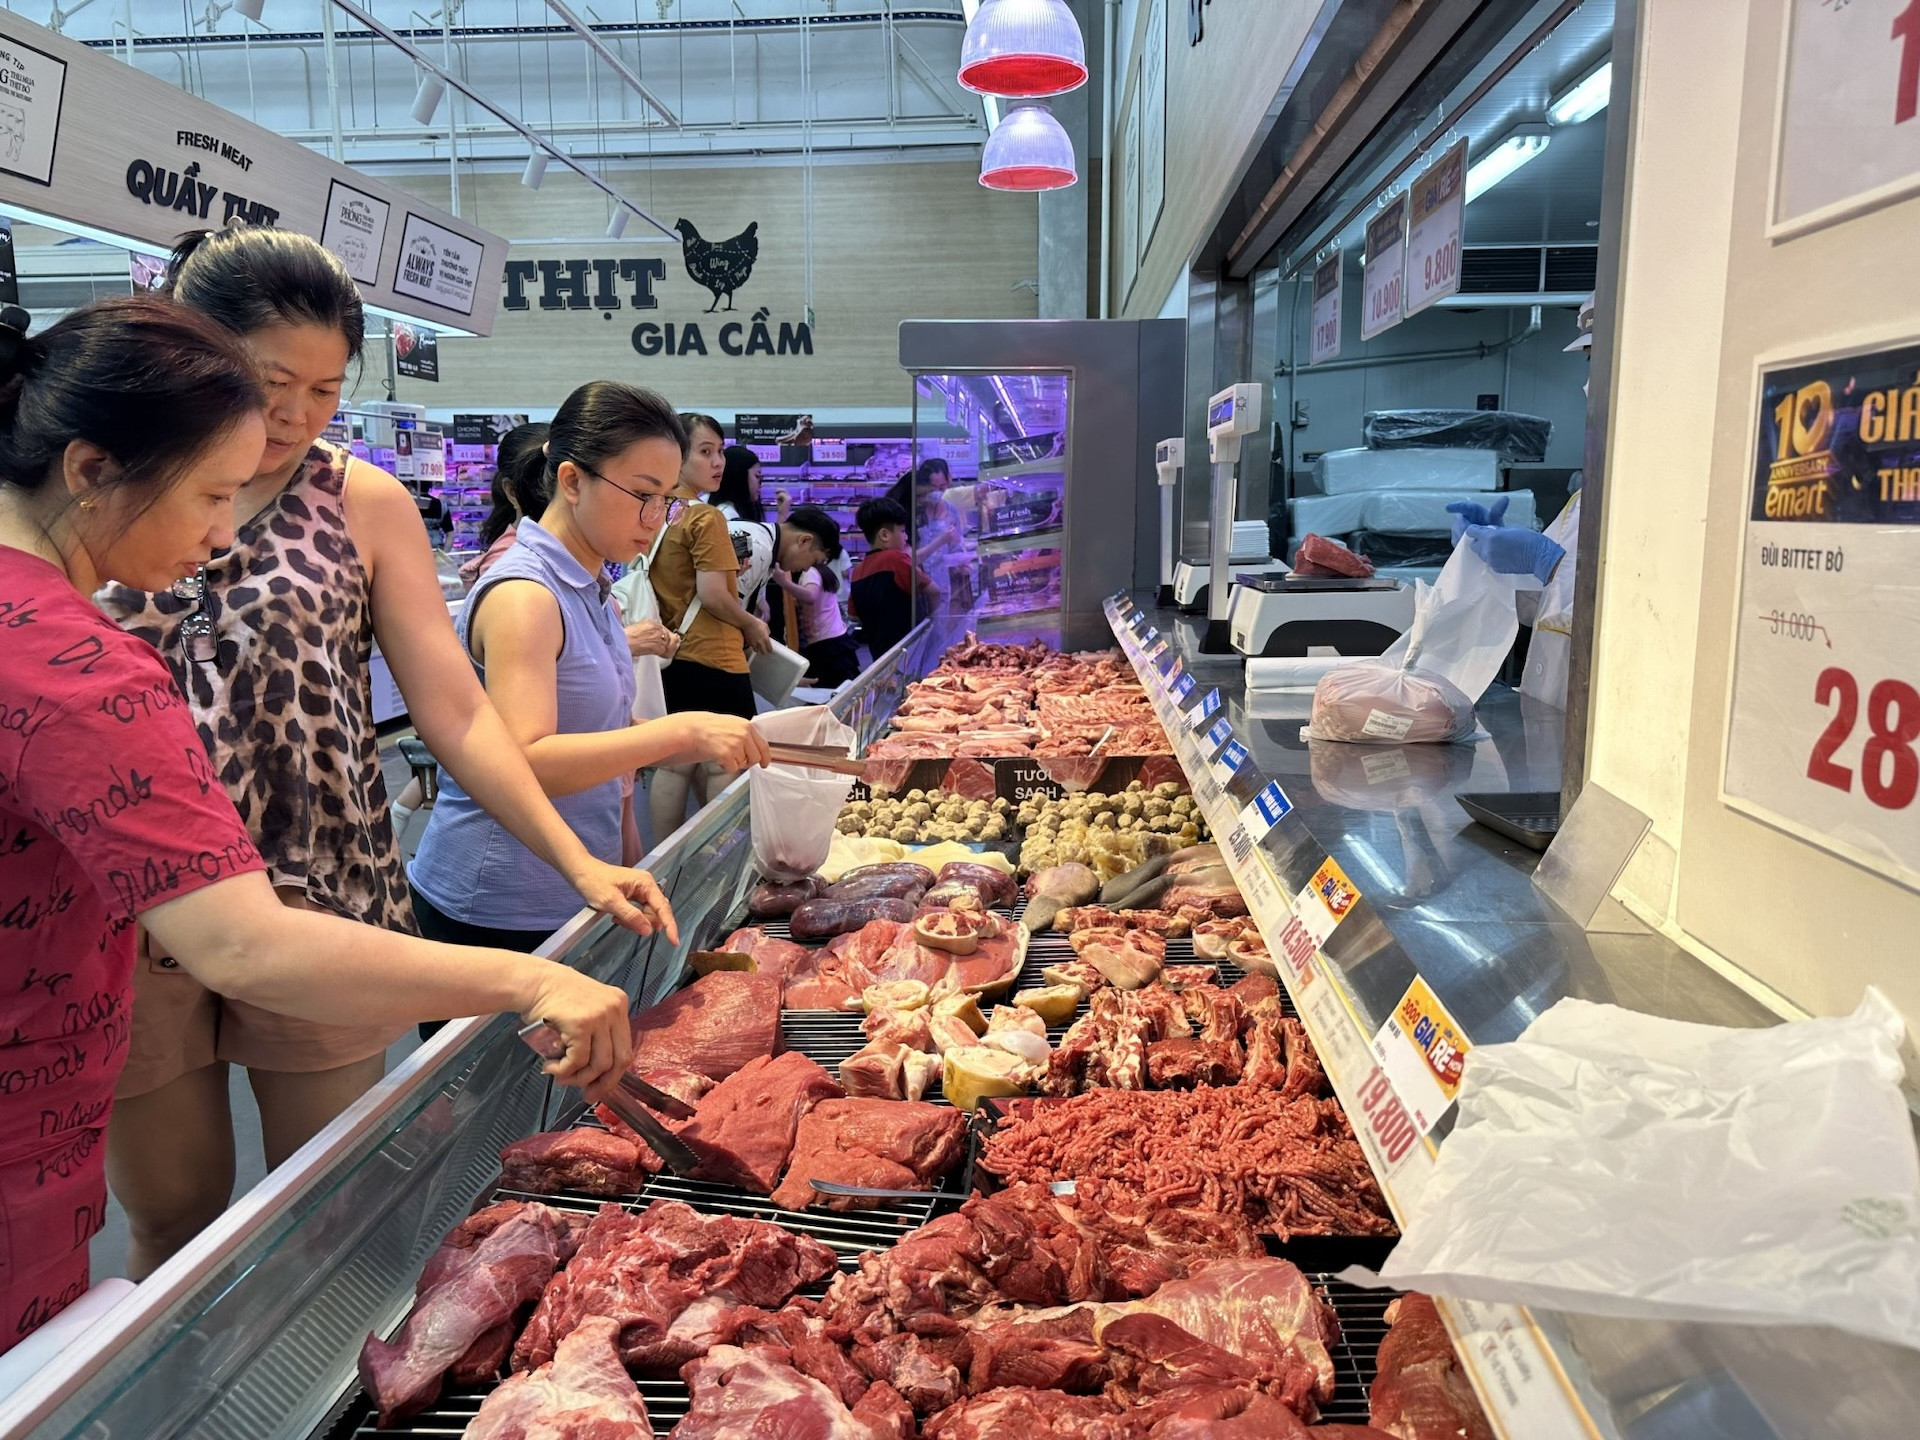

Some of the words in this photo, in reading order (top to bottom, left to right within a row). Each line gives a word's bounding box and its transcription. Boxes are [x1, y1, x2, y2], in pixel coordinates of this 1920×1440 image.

[177, 131, 219, 153] FRESH
[221, 142, 253, 172] MEAT
[126, 158, 218, 219] QUẦY
[406, 252, 435, 277] ALWAYS
[502, 258, 666, 320] THỊT
[709, 257, 729, 271] Wing
[1424, 238, 1457, 290] 9.800
[631, 322, 708, 356] GIA
[718, 306, 814, 356] CẦM
[1775, 381, 1834, 461] 10
[421, 463, 443, 476] 27.900
[1765, 480, 1827, 518] emart
[1761, 542, 1779, 566] ĐÙI
[1781, 547, 1823, 570] BITTET
[1825, 546, 1844, 572] BÒ
[1770, 609, 1816, 642] 31.000
[1279, 916, 1317, 971] 18.500
[1402, 998, 1421, 1025] 3000
[1413, 1015, 1440, 1053] GIÁ
[1429, 1037, 1459, 1073] RẺ
[1356, 1066, 1417, 1164] 19.800
